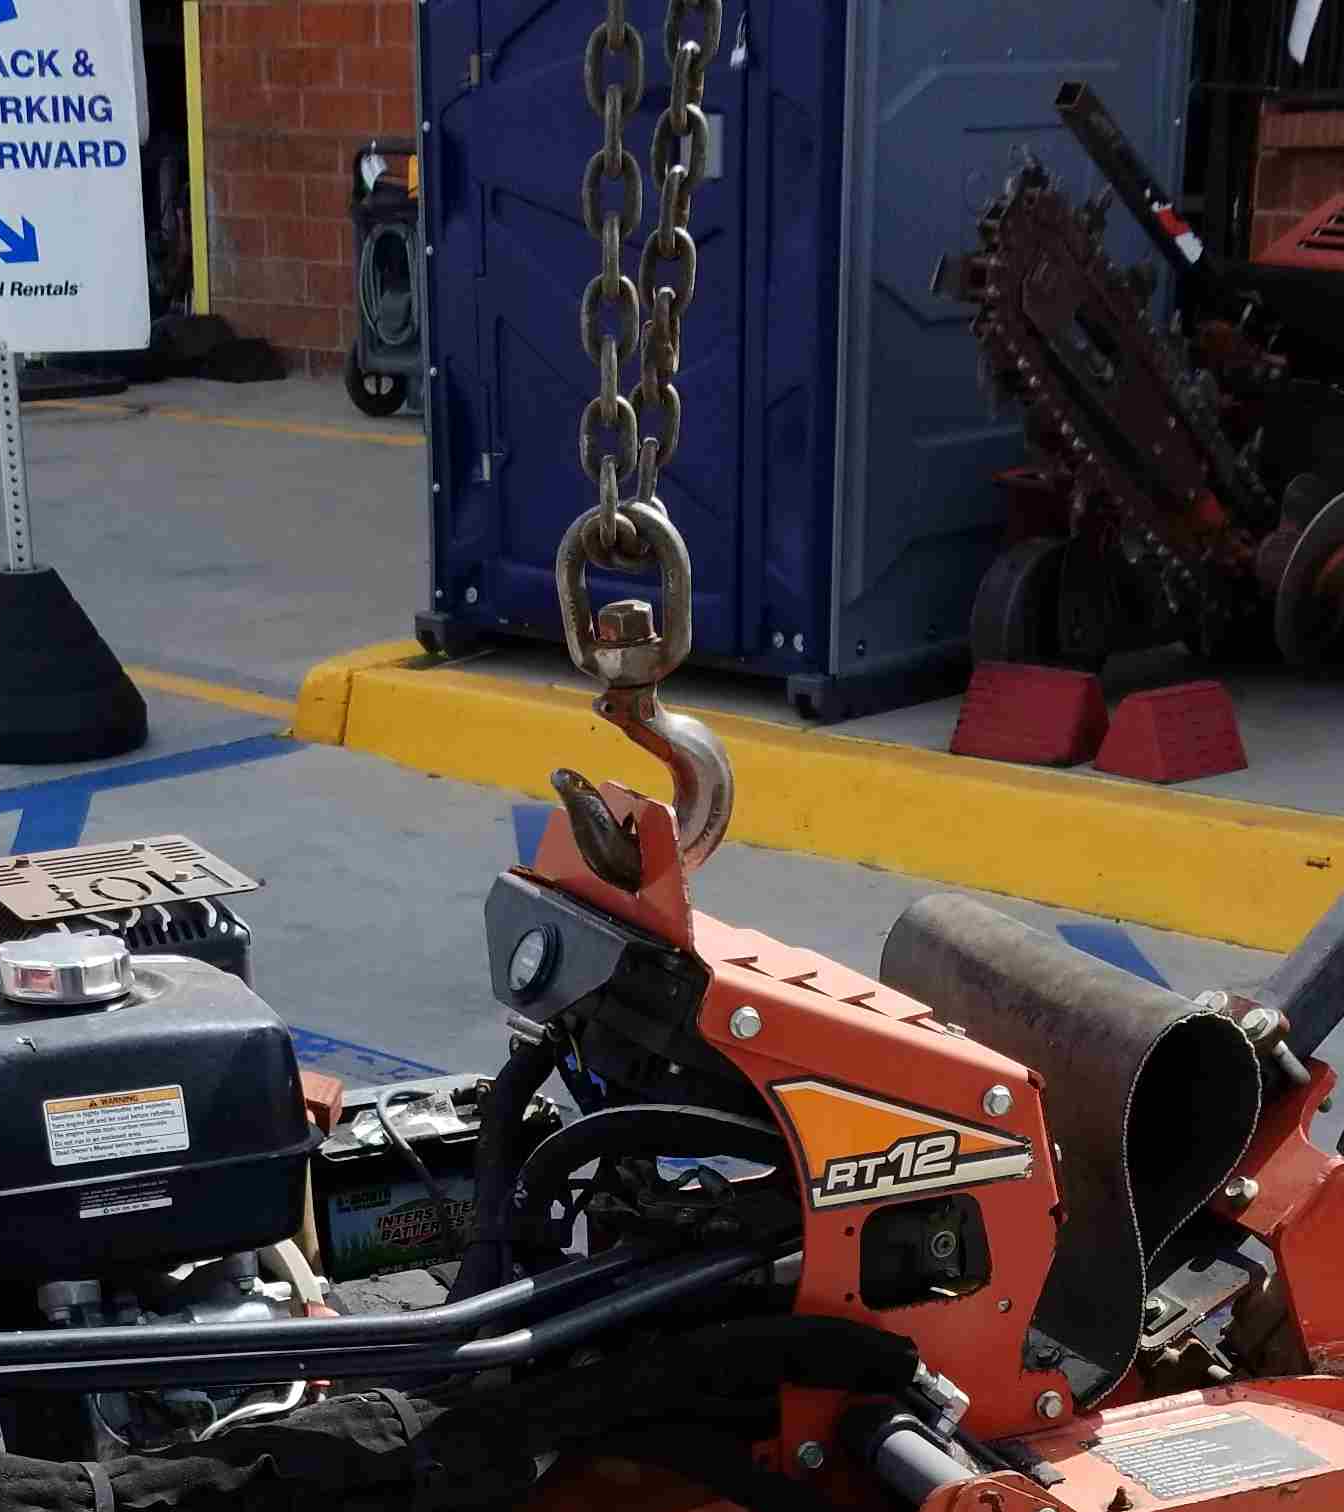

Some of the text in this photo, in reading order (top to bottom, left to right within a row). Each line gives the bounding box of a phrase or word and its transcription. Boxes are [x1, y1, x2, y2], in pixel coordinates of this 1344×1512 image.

[71, 48, 97, 78] &
[10, 279, 80, 297] Rentals
[825, 1134, 956, 1191] RT12
[376, 1200, 474, 1229] INTERSATE
[382, 1216, 466, 1241] BATTERES
